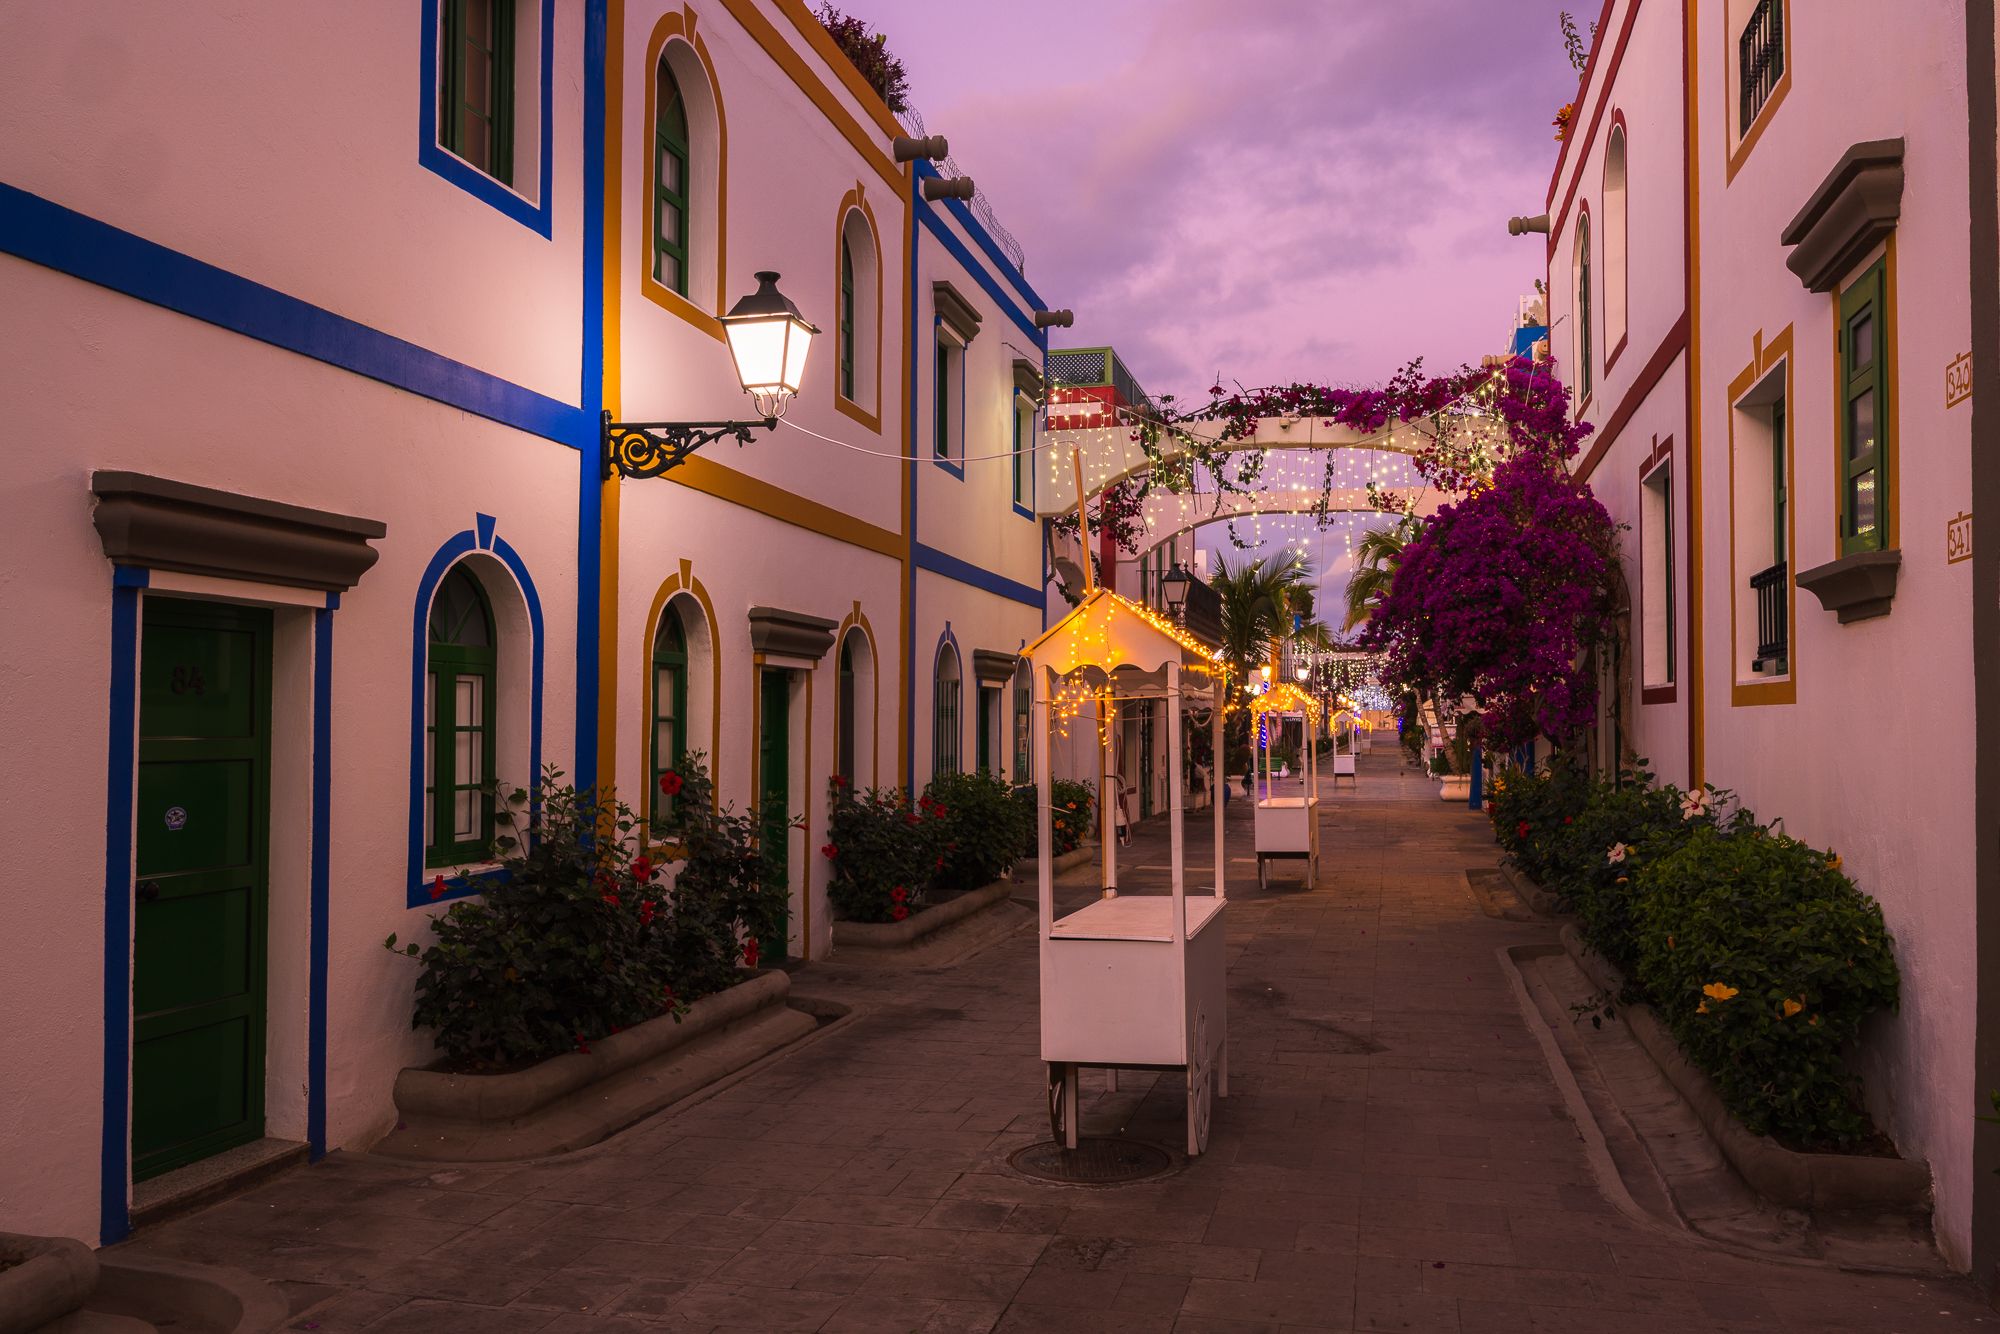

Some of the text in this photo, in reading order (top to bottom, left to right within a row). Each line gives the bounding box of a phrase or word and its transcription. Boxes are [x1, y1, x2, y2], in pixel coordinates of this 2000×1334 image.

[1948, 363, 1971, 399] 340
[1949, 521, 1971, 557] 341
[171, 665, 206, 695] 84
